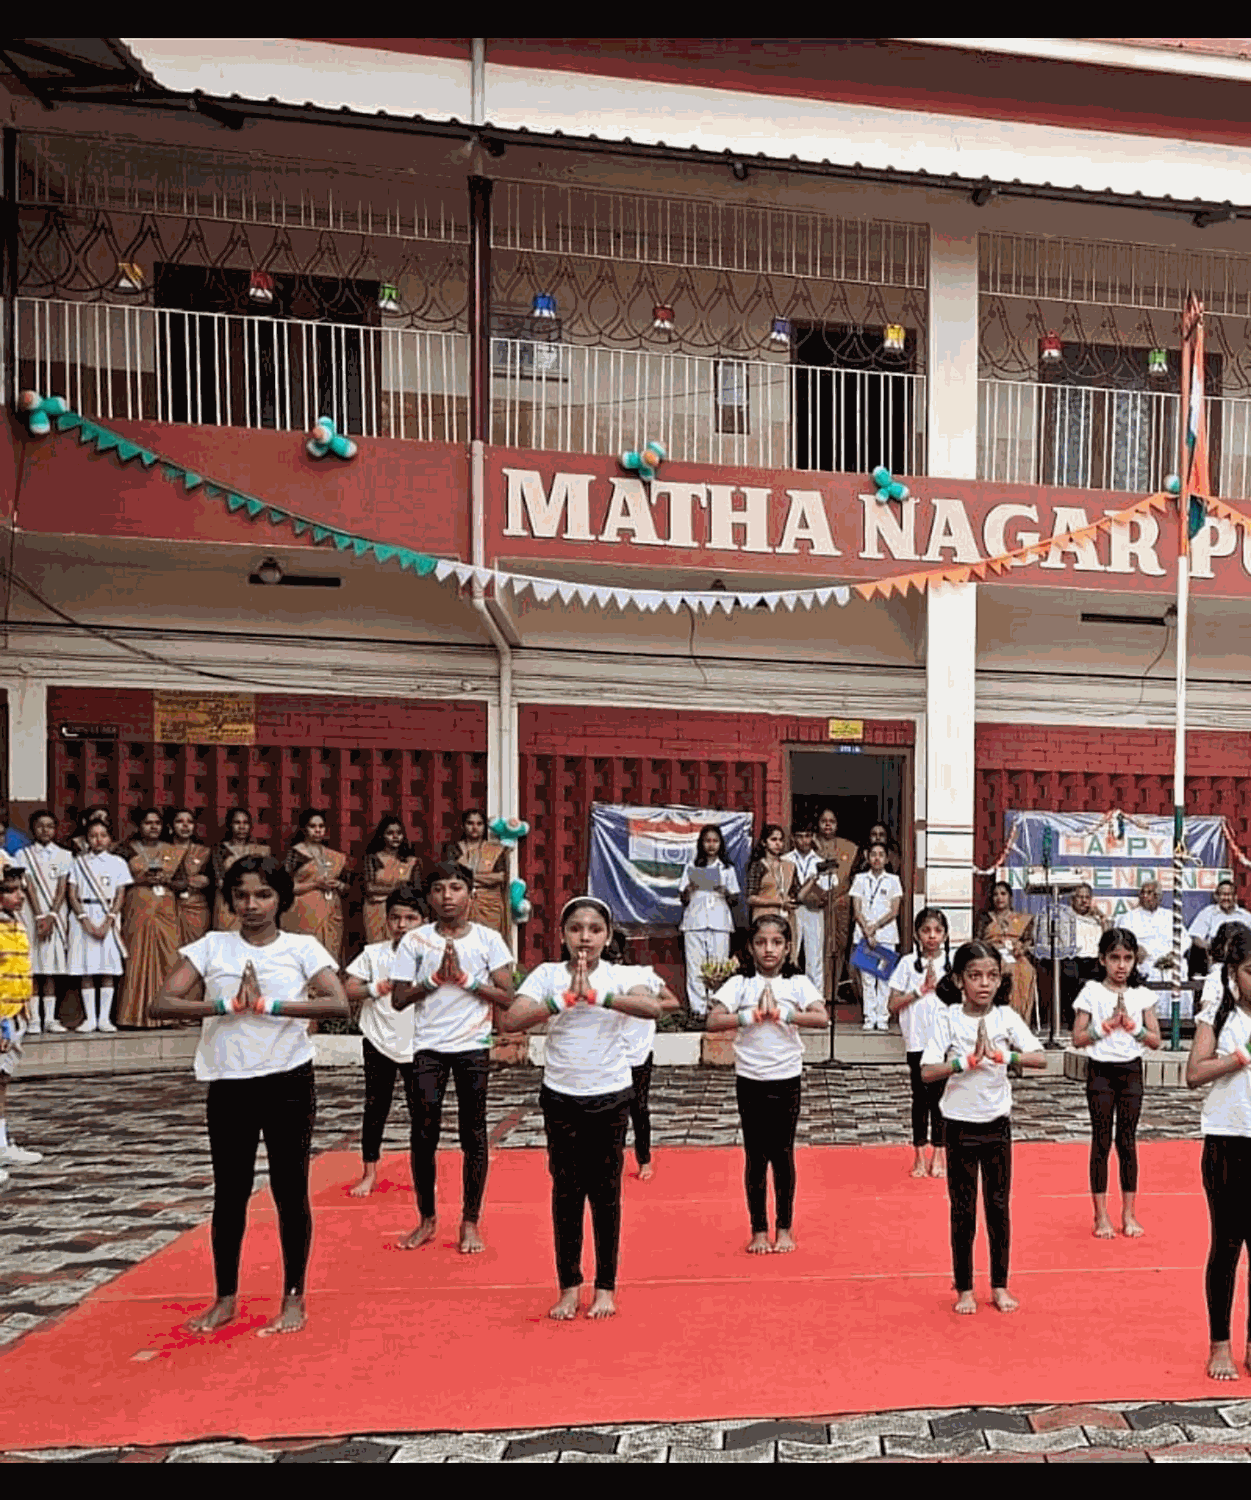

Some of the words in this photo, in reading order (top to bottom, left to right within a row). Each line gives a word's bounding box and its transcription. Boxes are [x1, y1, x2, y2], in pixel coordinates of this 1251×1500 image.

[502, 468, 842, 558] MATHA
[859, 493, 1167, 576] NAGAR
[1064, 834, 1166, 855] HAPPY
